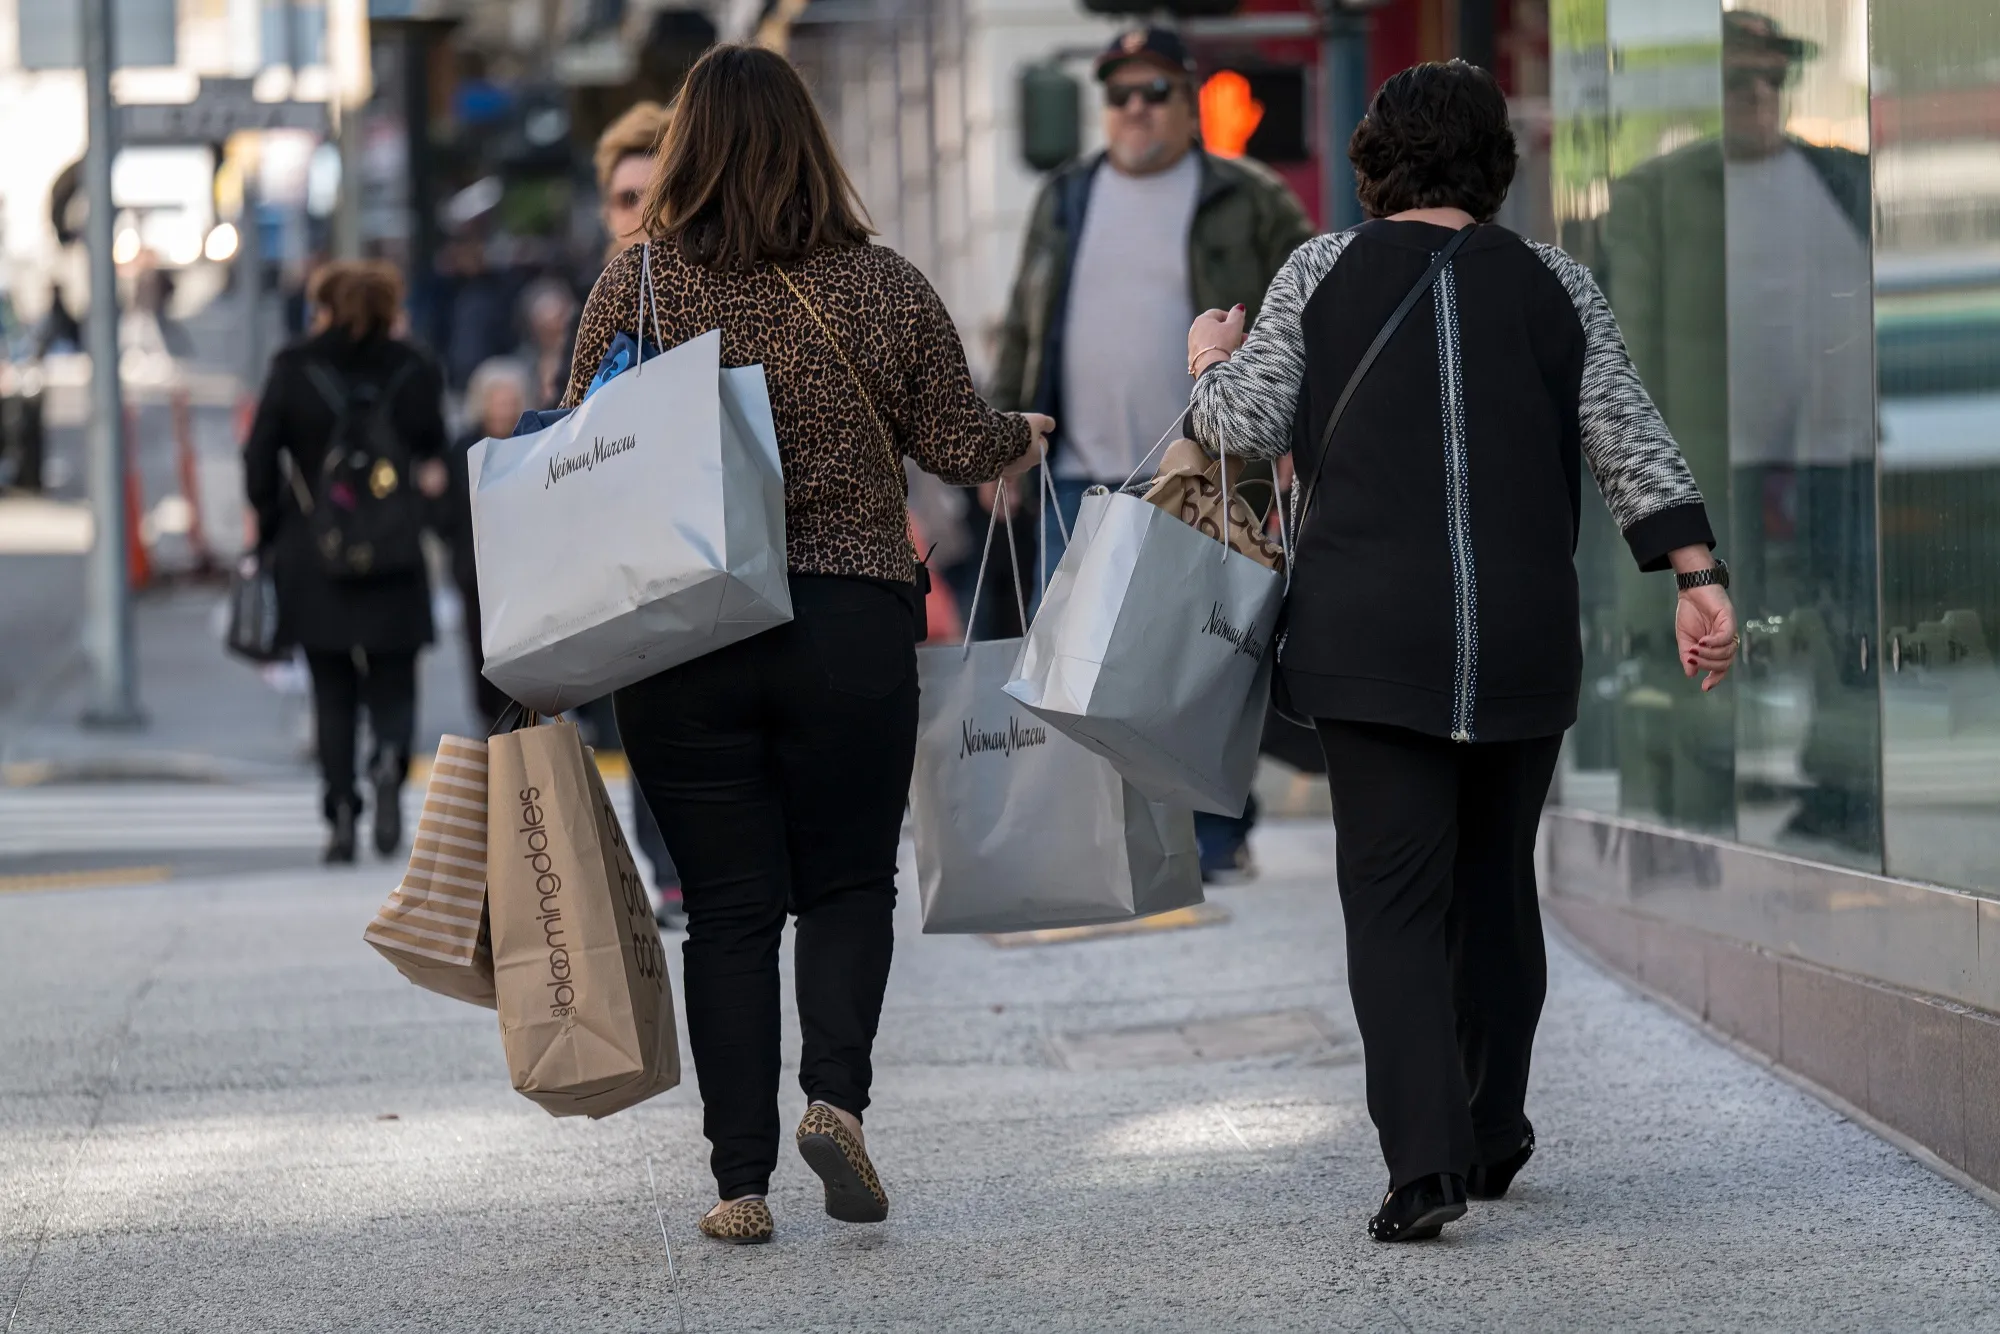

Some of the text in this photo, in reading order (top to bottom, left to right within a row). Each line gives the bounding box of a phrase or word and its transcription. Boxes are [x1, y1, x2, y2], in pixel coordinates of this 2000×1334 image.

[545, 433, 636, 490] Neiman Marcus
[1202, 600, 1243, 647] Neiman
[960, 715, 1046, 760] Neiman Marcus
